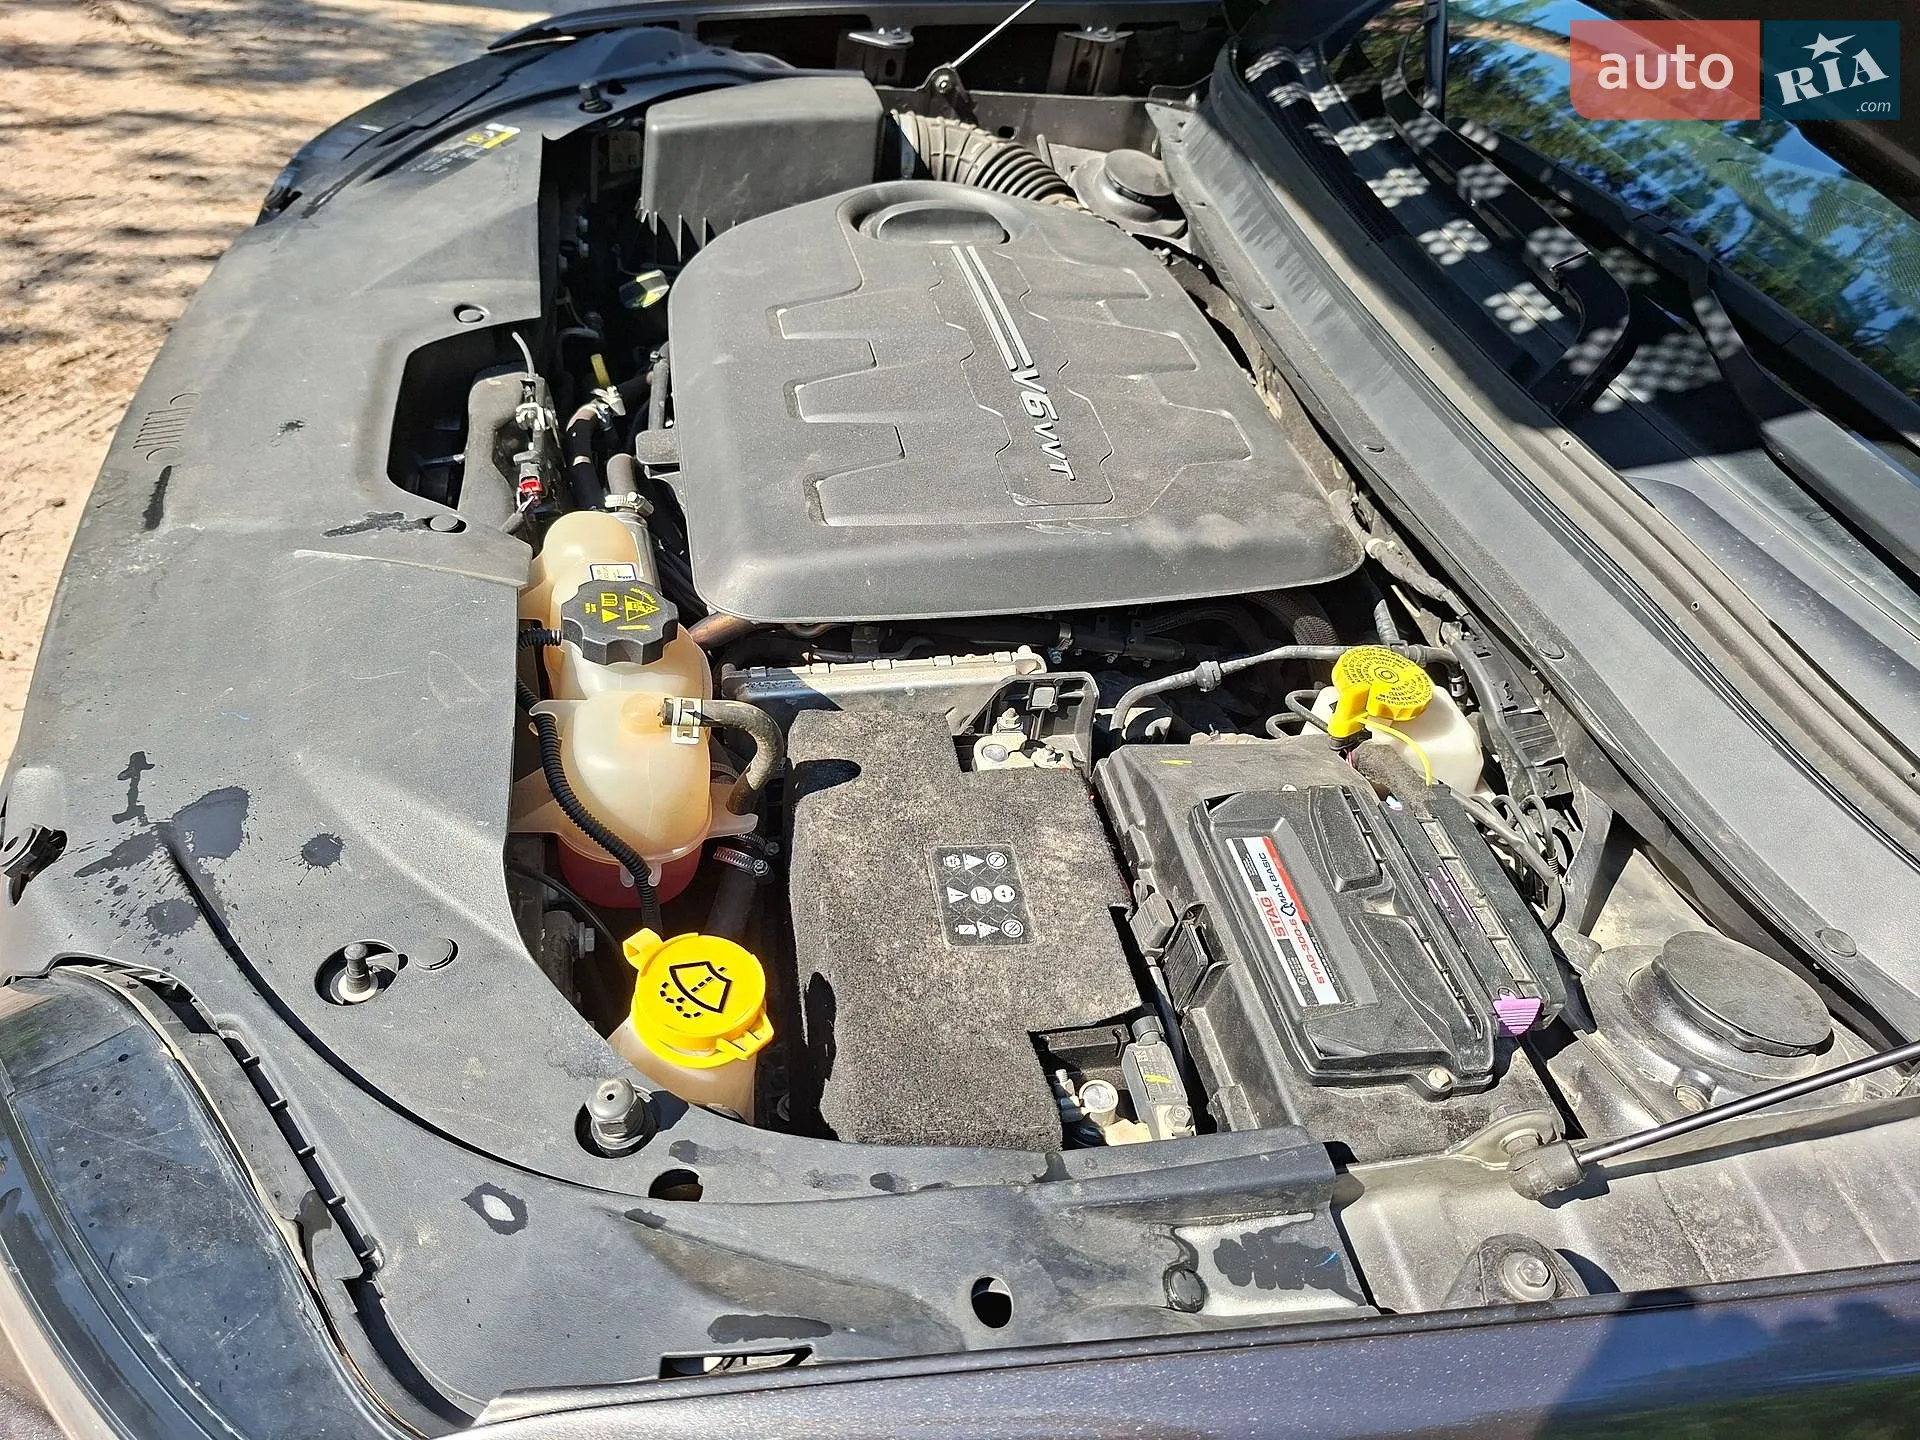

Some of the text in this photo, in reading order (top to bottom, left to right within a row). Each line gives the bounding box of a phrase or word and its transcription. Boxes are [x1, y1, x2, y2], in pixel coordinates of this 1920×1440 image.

[1011, 369, 1077, 481] V6 VVT
[1258, 851, 1278, 882] BASIC
[1260, 896, 1288, 938] STAG
[1288, 917, 1326, 985] STAG-300-6
